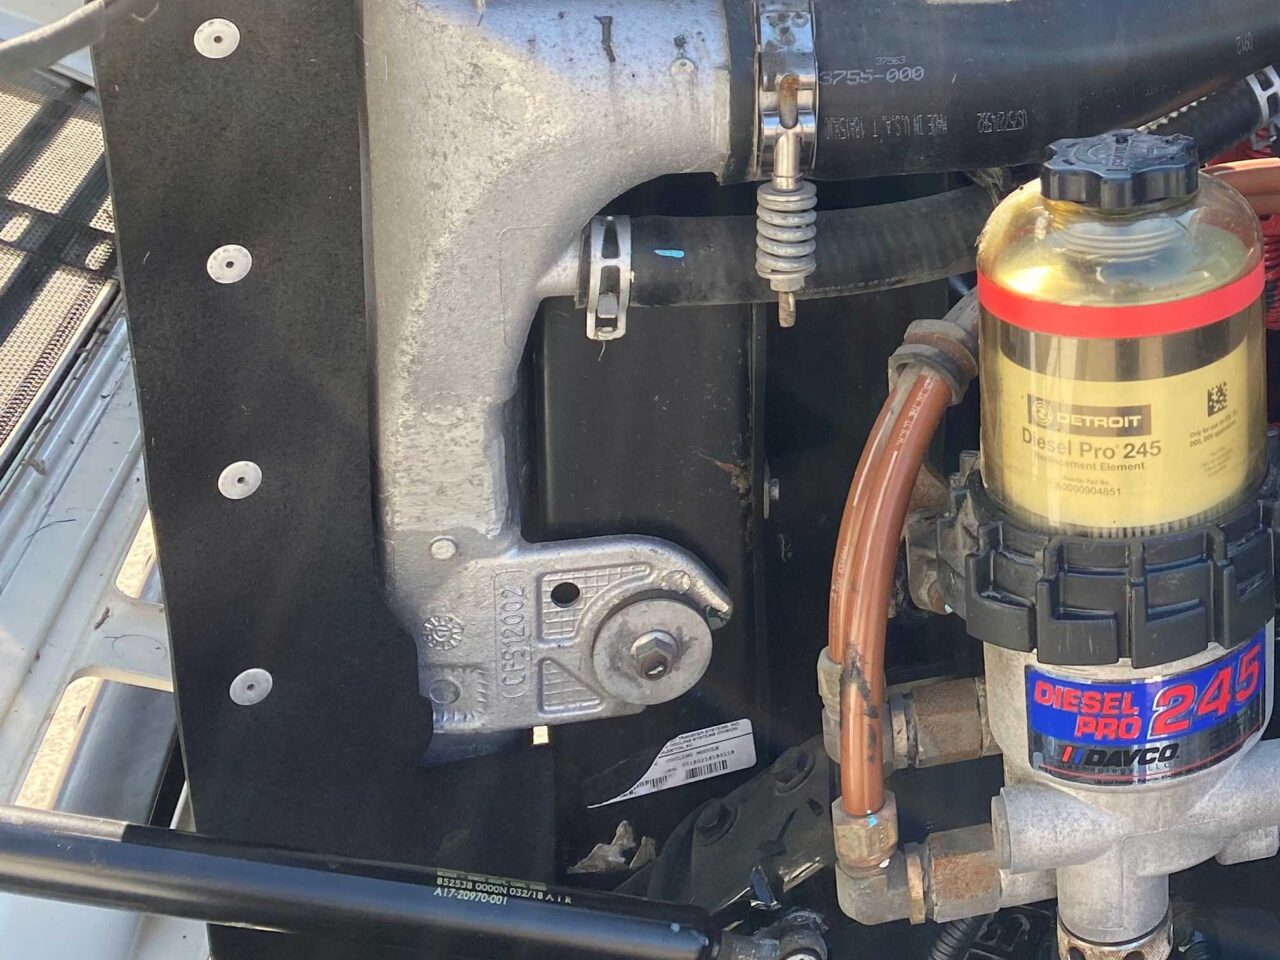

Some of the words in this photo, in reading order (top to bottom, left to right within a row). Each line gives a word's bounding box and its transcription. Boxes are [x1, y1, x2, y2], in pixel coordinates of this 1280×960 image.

[1056, 413, 1142, 429] DETROIT
[1022, 427, 1073, 456] Diesel
[1122, 440, 1162, 460] 245
[1100, 461, 1146, 472] Element
[1034, 680, 1140, 716] DIESEL
[1146, 644, 1262, 740] 245
[1074, 714, 1143, 739] PRO
[433, 887, 508, 905] A17-20970-001
[437, 878, 473, 889] 852538
[509, 887, 543, 900] 032/18
